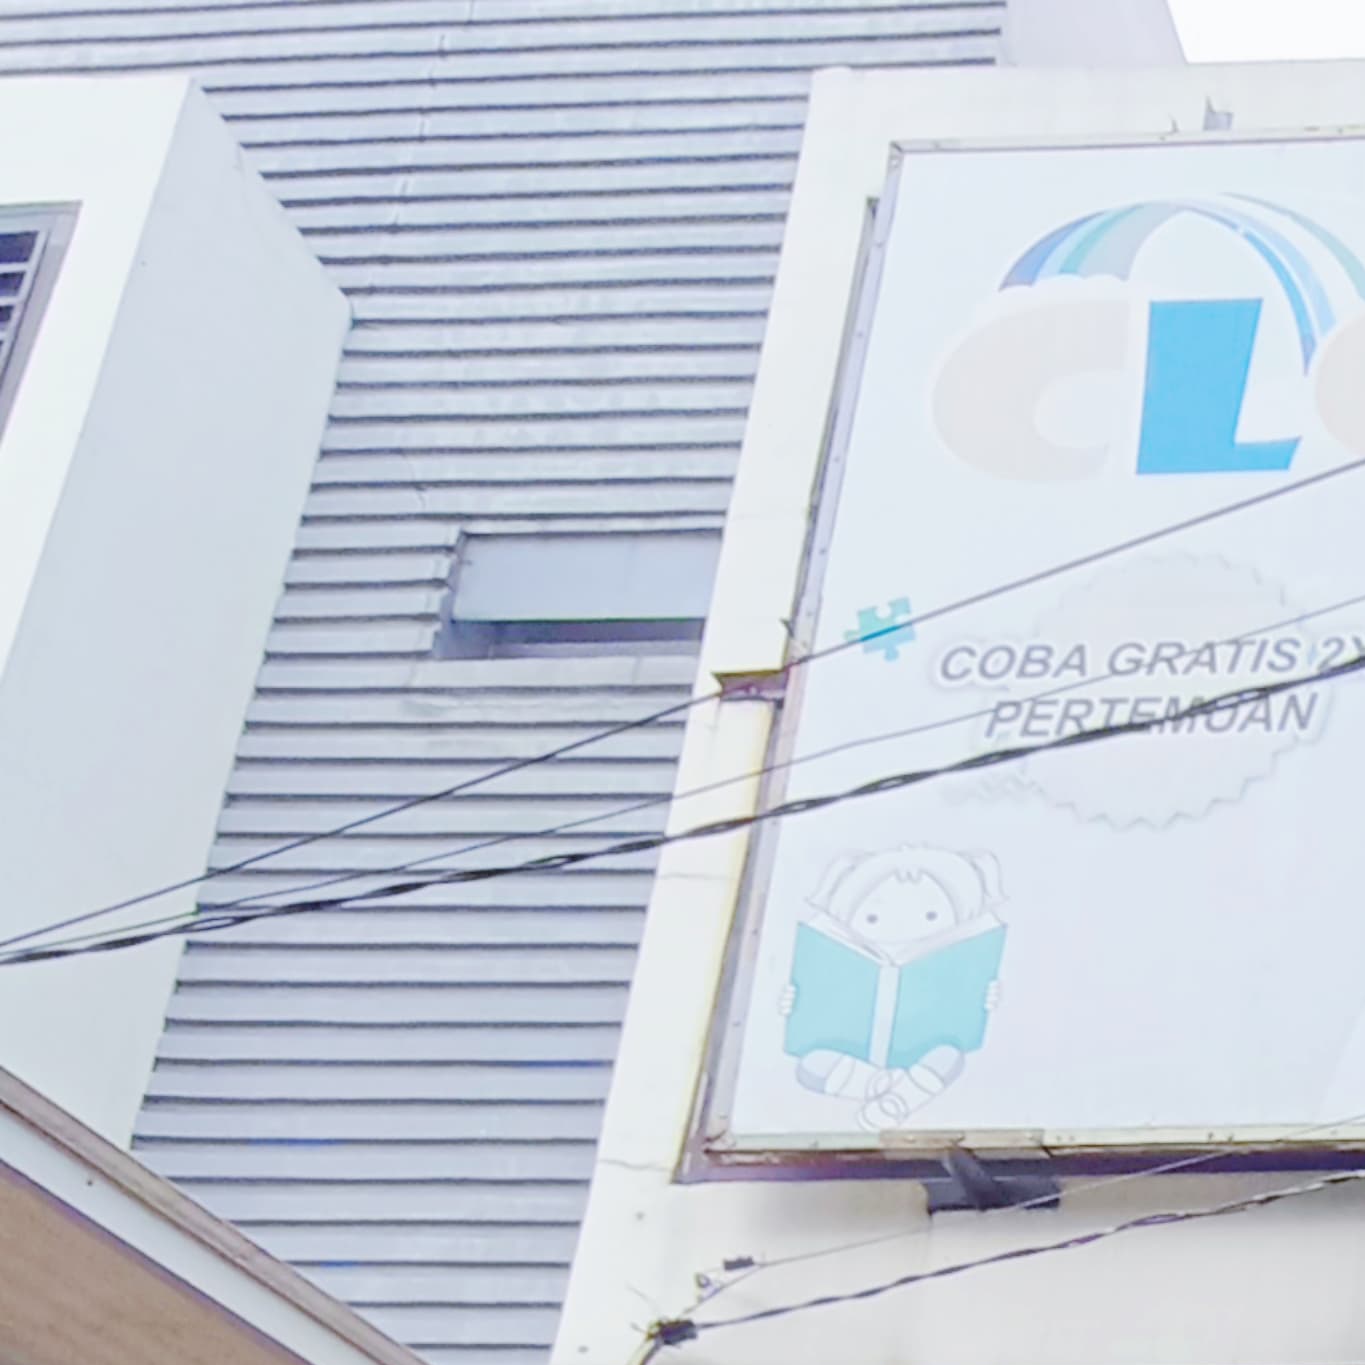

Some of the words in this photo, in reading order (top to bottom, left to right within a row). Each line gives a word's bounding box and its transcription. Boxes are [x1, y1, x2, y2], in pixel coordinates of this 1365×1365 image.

[940, 643, 1089, 682] COBA
[1108, 636, 1300, 676] GRATIS
[983, 692, 1319, 738] PERTEMUAN
